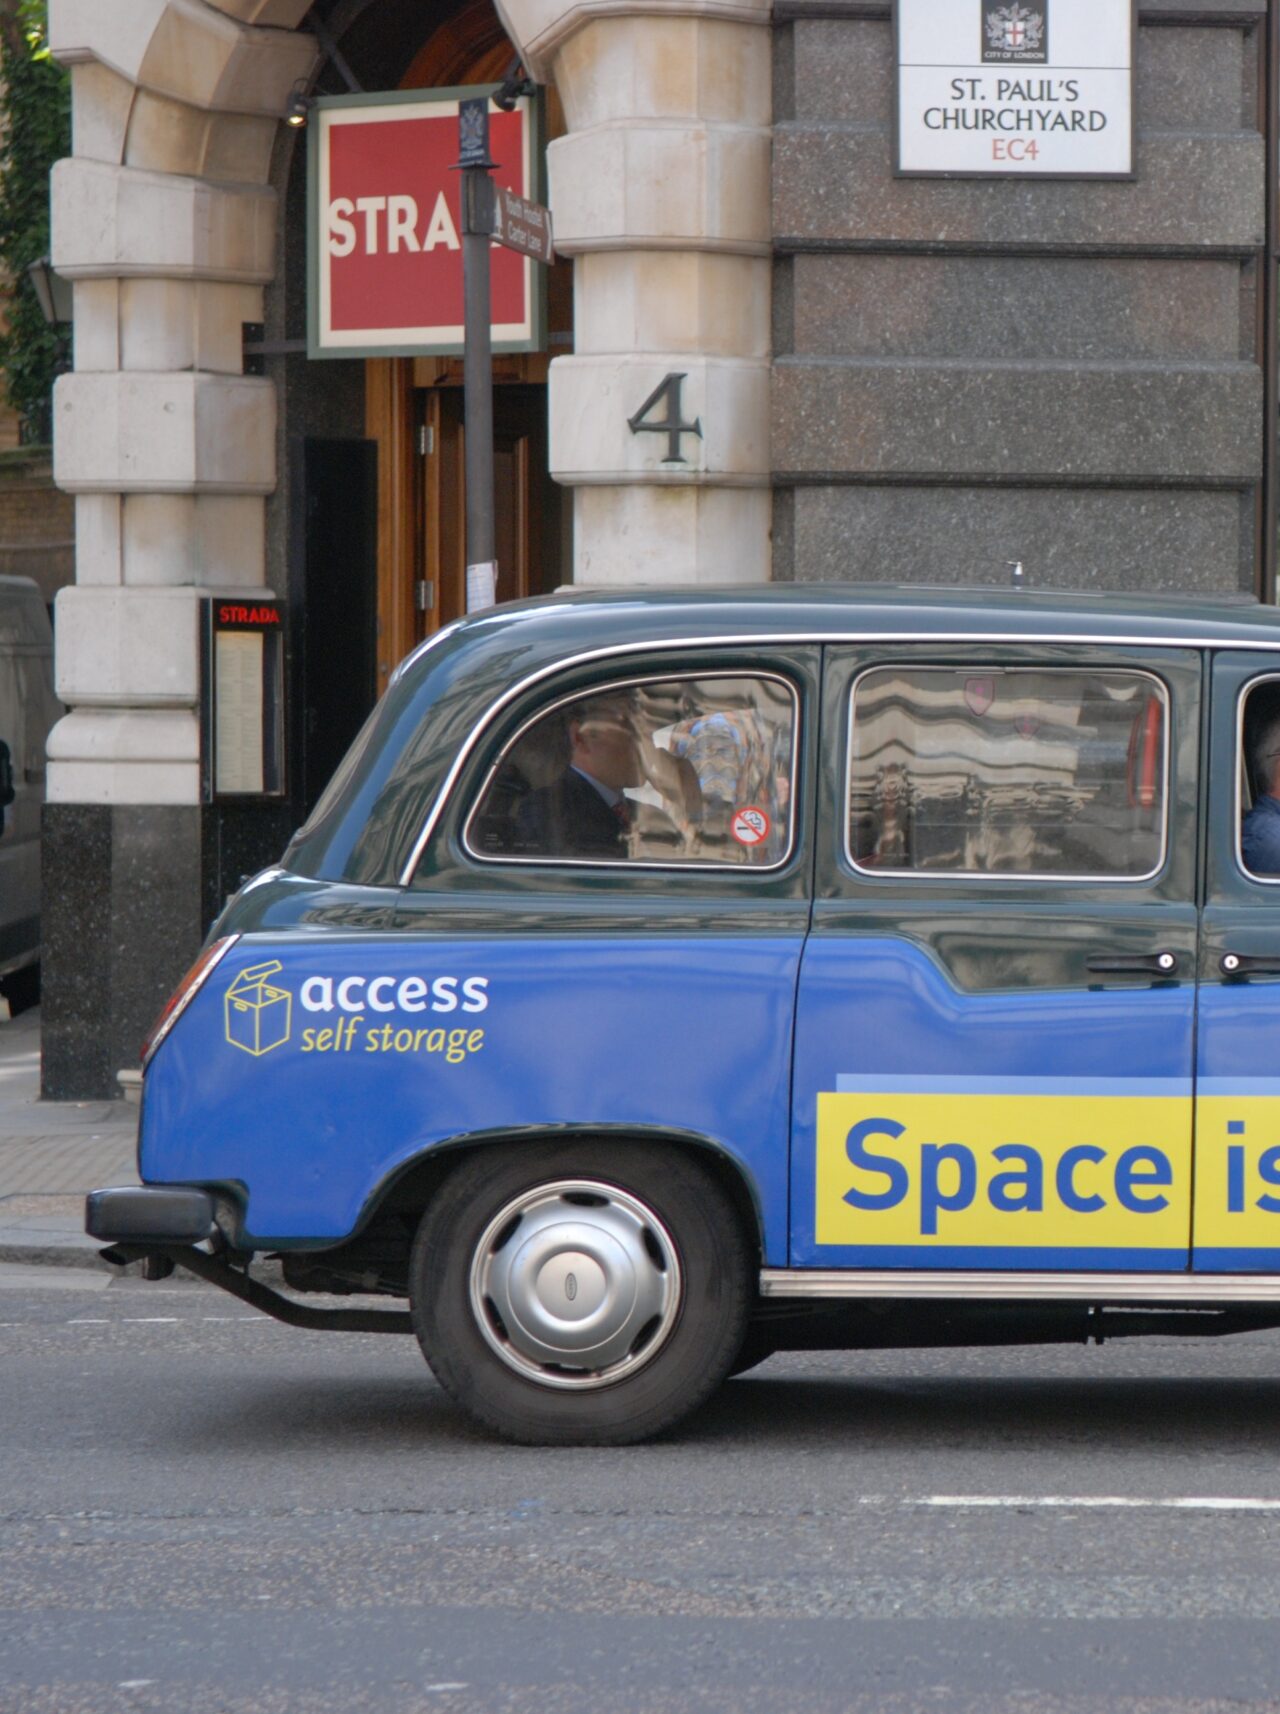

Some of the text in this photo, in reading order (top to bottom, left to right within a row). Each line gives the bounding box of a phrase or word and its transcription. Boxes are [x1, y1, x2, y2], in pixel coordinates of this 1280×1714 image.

[983, 50, 1045, 60] CITY OF LONDON
[951, 78, 1079, 102] ST. PAUL'S
[923, 107, 1107, 132] CHURCHYARD
[991, 138, 1039, 161] EC4
[626, 372, 704, 463] 4
[219, 605, 280, 624] STRADA
[300, 975, 489, 1013] access
[300, 1016, 485, 1064] self storage
[841, 1116, 1173, 1236] Space
